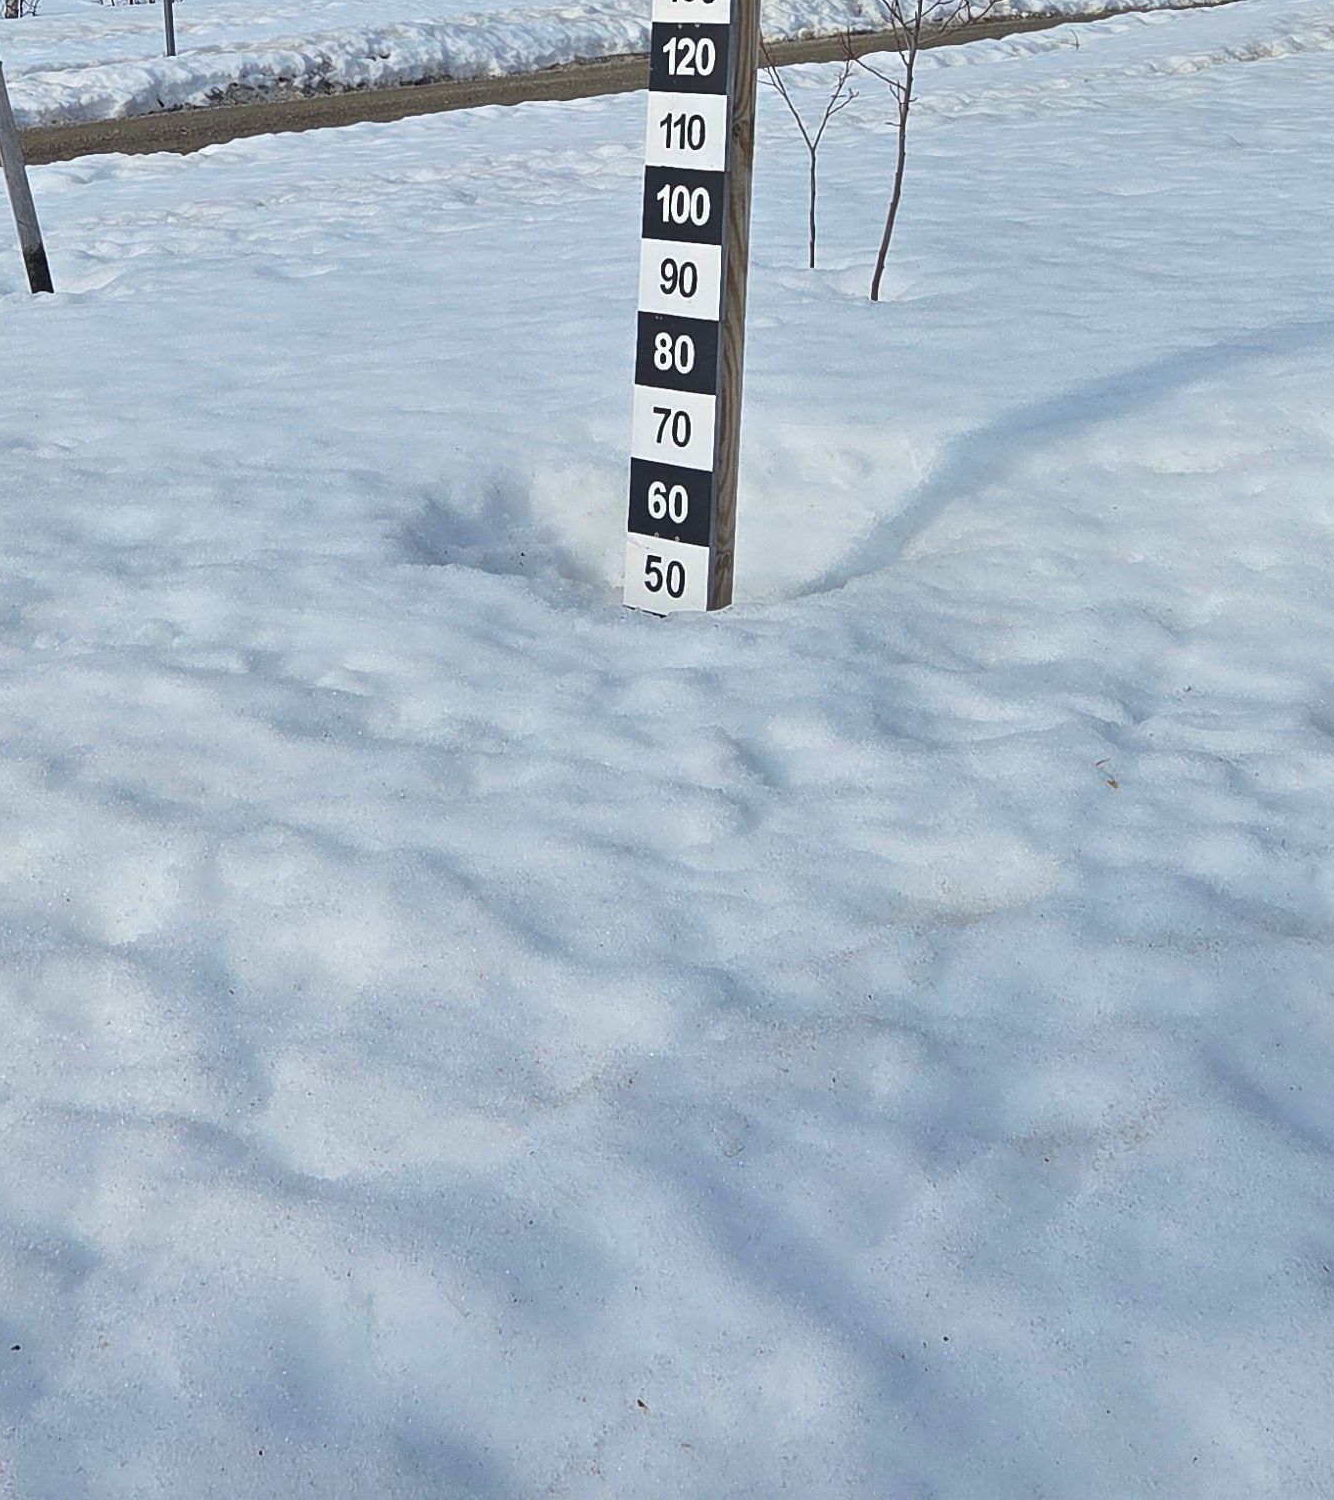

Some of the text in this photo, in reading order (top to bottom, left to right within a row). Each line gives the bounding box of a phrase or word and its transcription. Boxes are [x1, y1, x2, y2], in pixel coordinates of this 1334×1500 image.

[662, 37, 716, 77] 120
[660, 113, 706, 151] 110
[656, 184, 711, 226] 100
[659, 258, 698, 298] 90
[653, 331, 695, 375] 80
[652, 406, 692, 448] 70
[647, 480, 689, 524] 60
[644, 554, 686, 599] 50
